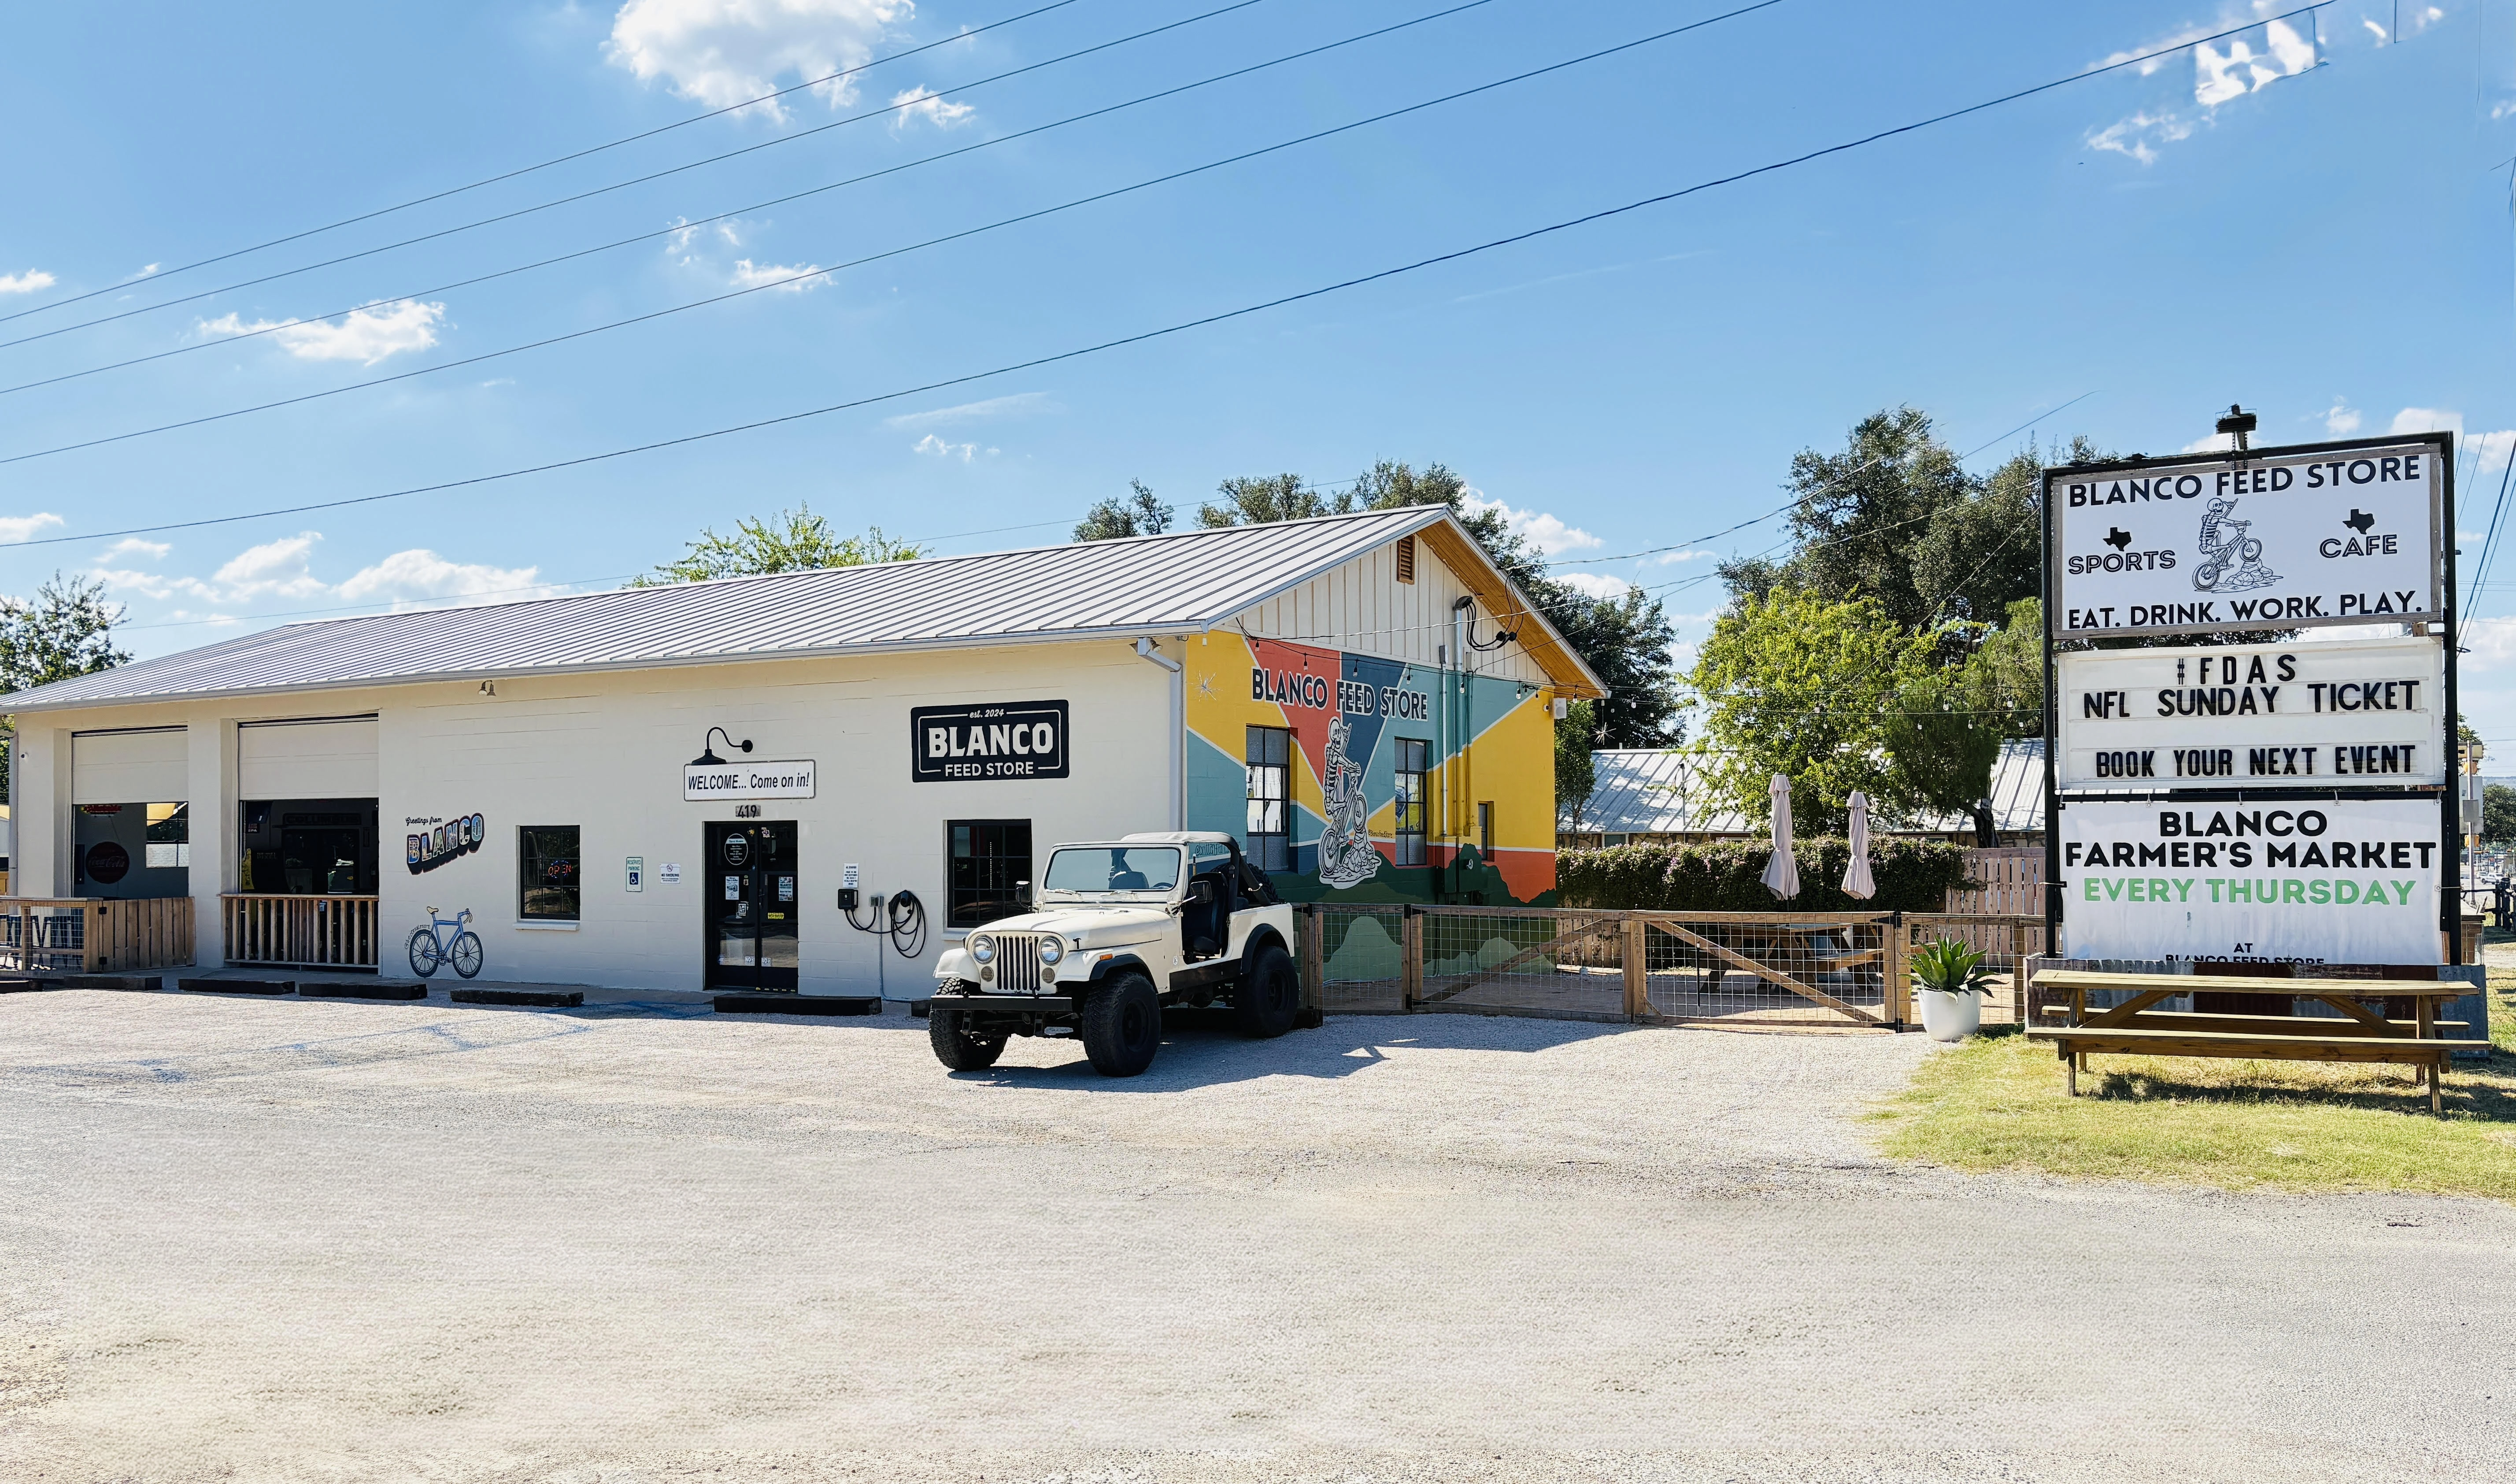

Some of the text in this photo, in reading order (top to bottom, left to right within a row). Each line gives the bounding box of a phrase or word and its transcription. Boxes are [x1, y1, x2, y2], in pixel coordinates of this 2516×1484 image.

[2069, 455, 2420, 507] BLANCO FEED STORE
[2320, 534, 2398, 559] CAFE
[2068, 550, 2176, 574] SPORTS
[2068, 590, 2423, 629] EAT. DRINK. WORK. PLAY.
[1251, 666, 1428, 721] BLANCO FEED STORE
[2083, 680, 2420, 719] NFL SUNDAY TICKET
[984, 709, 1004, 717] 2024
[929, 722, 1053, 758] BLANCO
[945, 762, 1034, 777] FEED STORE
[2096, 745, 2416, 778] BOOK YOUR NEXT EVENT
[688, 772, 810, 790] WELCOME... Come on in!
[406, 817, 429, 826] Greetings
[737, 805, 757, 818] 419
[2160, 810, 2327, 837] BLANCO
[407, 812, 485, 875] BLANCO
[2065, 841, 2437, 869] FARMER'S MARKET
[548, 865, 572, 876] OPEN
[2084, 878, 2416, 906] EVERY THURSDAY
[2234, 943, 2253, 953] AT
